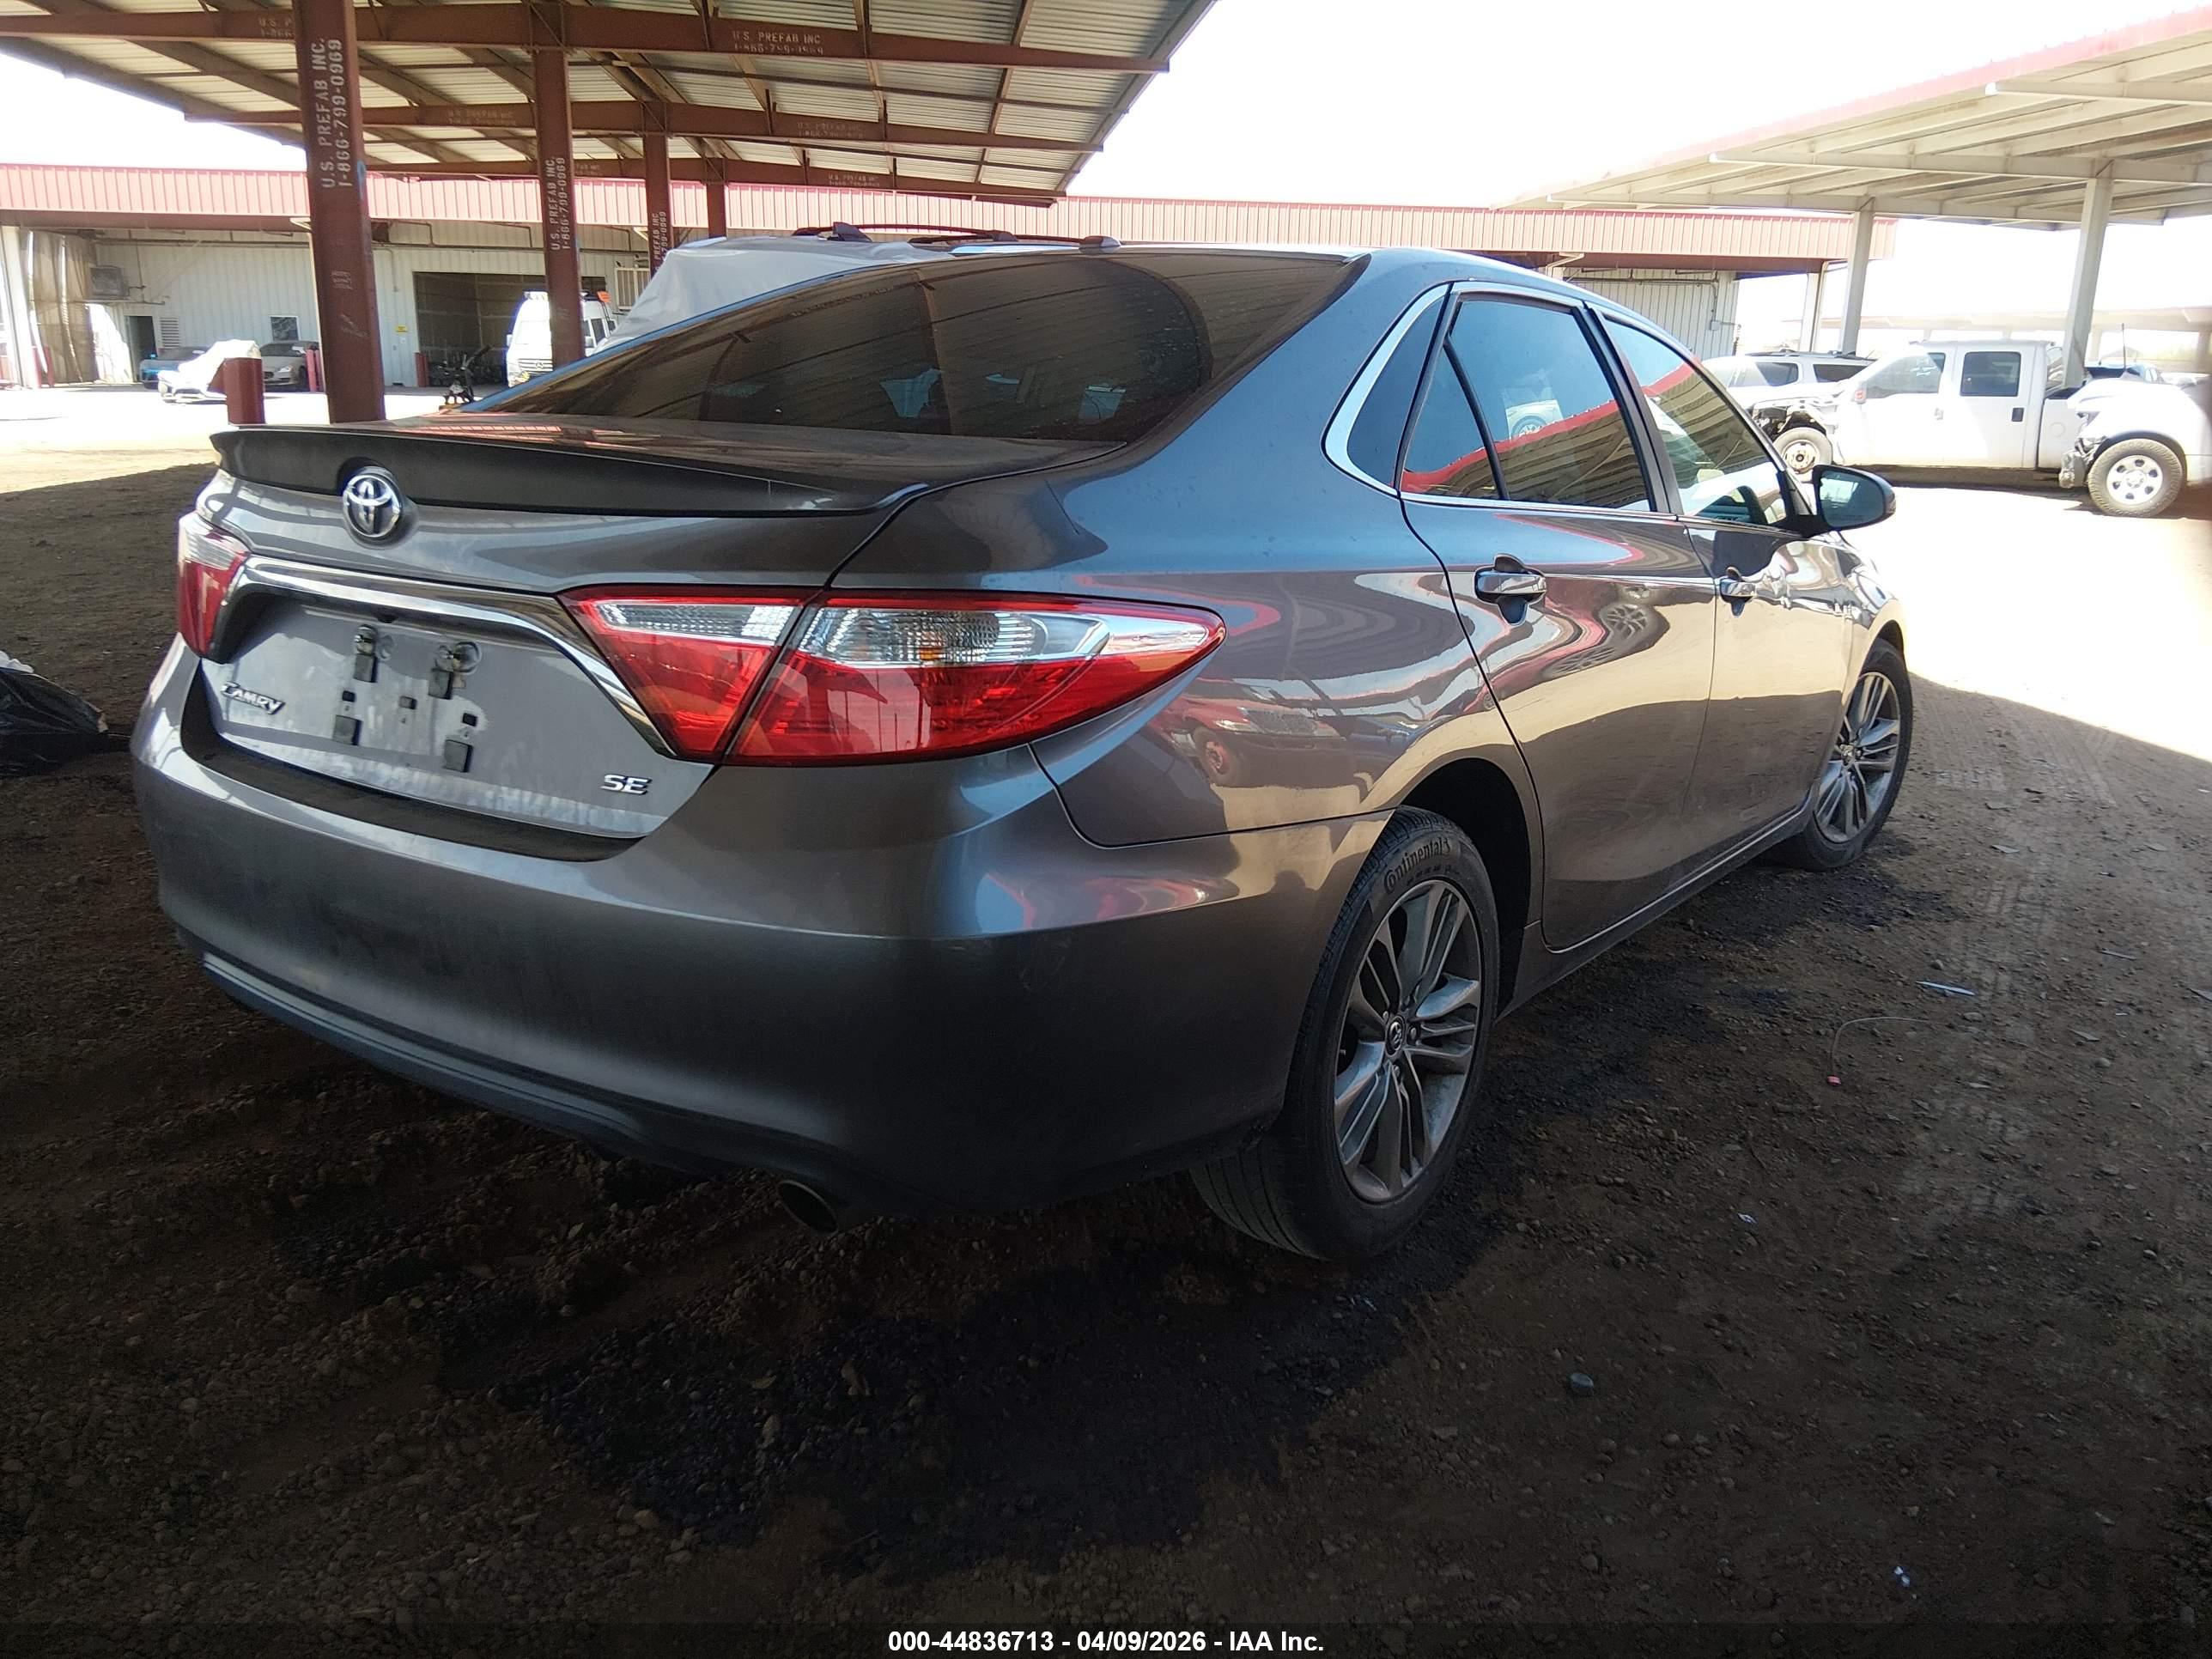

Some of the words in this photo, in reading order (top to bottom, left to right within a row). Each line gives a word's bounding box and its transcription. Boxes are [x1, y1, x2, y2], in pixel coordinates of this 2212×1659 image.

[758, 31, 799, 43] PREFAB
[311, 38, 327, 70] INC.
[313, 79, 332, 147] PREFAB
[328, 39, 352, 187] 1-866-799-0969
[320, 155, 336, 188] U.S.
[547, 181, 559, 224] PREFAB
[550, 229, 561, 251] U.S.
[220, 681, 286, 715] CAMRY
[601, 774, 652, 795] SE
[1384, 836, 1444, 894] Continental
